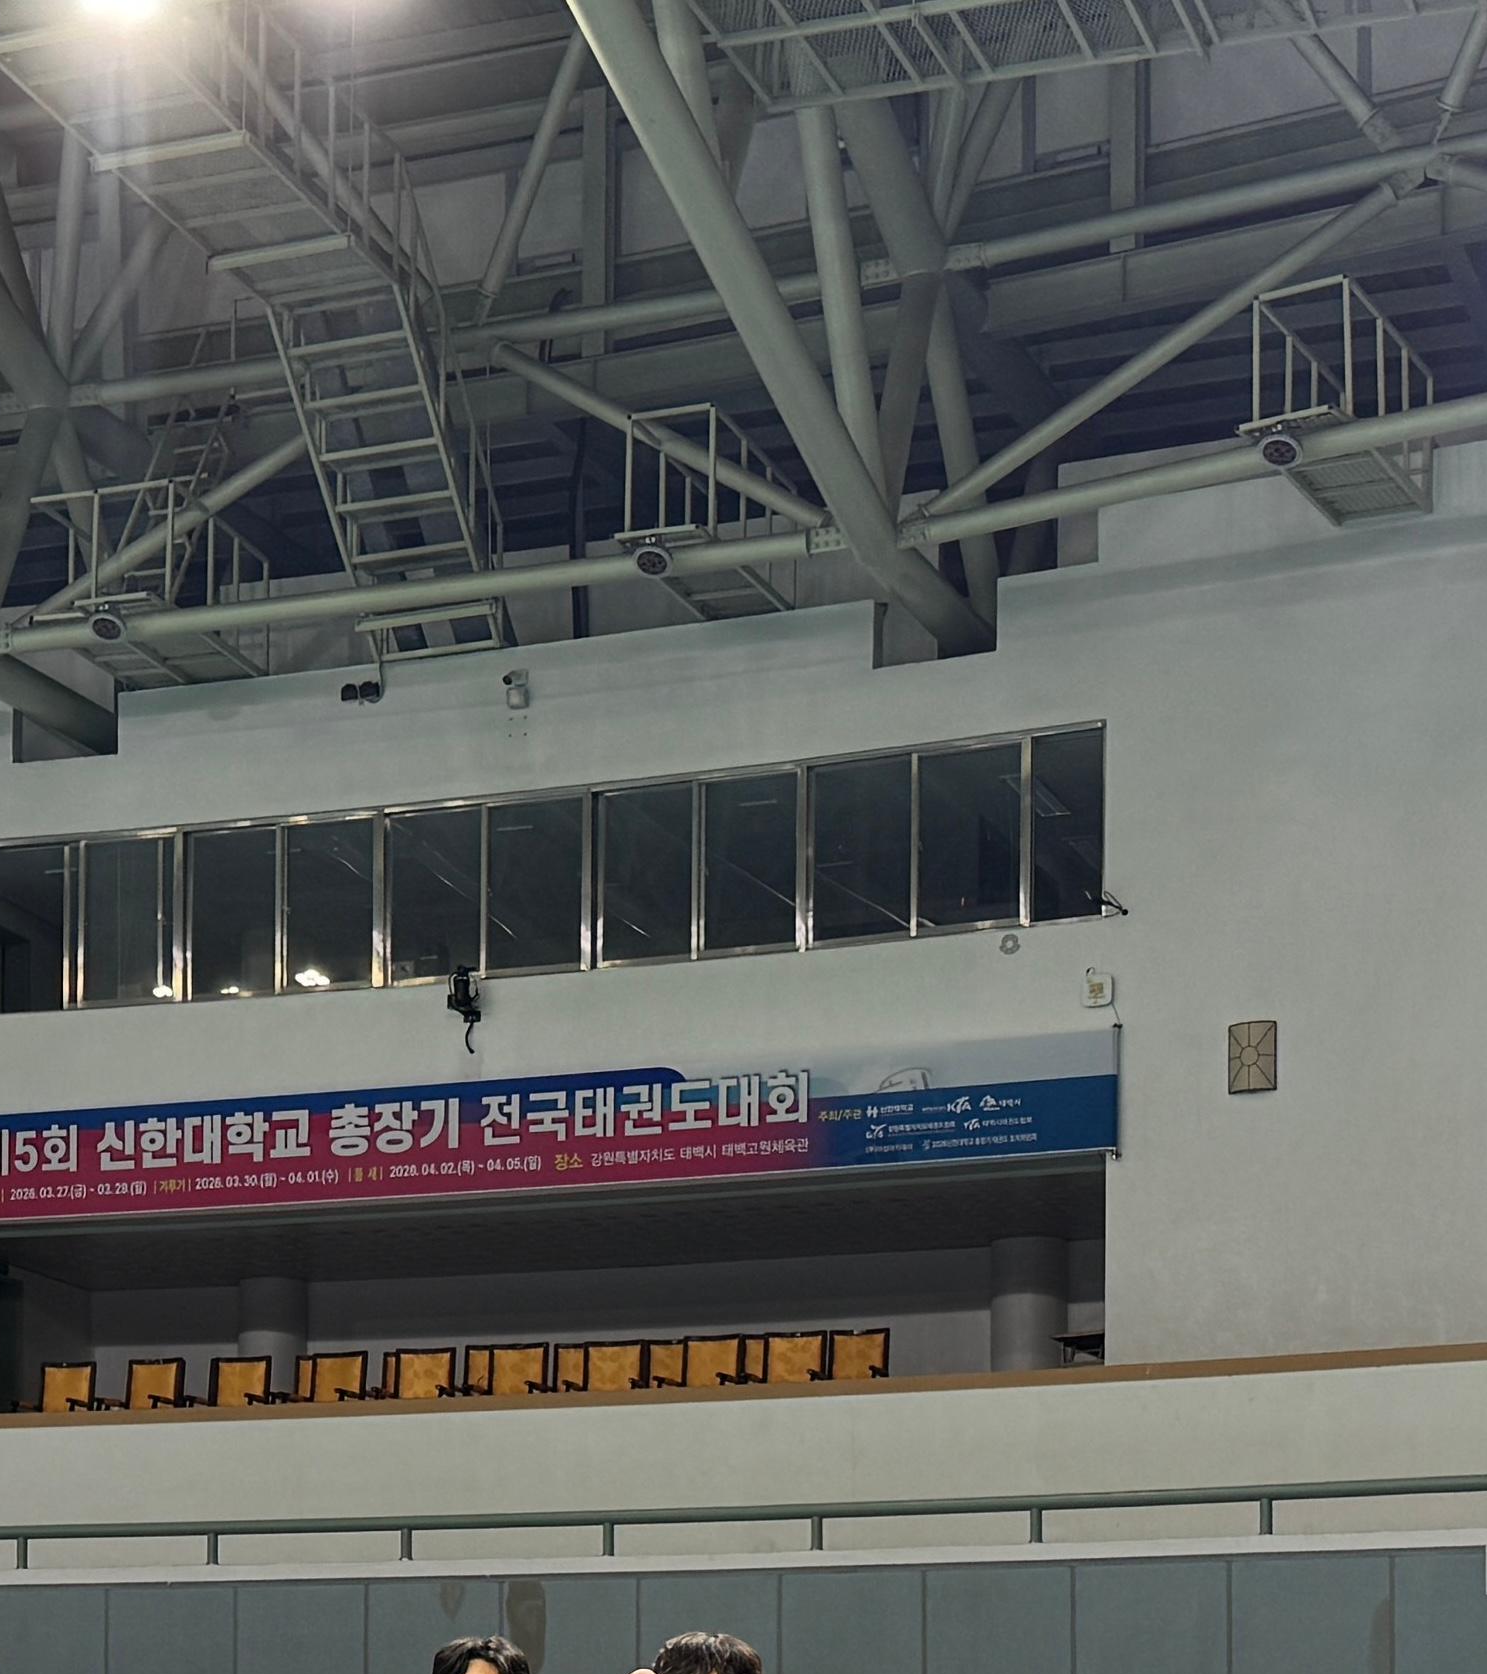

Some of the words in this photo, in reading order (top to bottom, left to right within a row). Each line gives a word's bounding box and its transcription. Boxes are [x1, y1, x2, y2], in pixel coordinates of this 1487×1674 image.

[97, 1109, 311, 1171] 신한대학교
[329, 1098, 459, 1157] 총장기
[480, 1071, 809, 1147] 전국태권도대회
[554, 1153, 583, 1170] 장소
[591, 1148, 675, 1167] 강원특별자치도
[680, 1144, 717, 1159] 태백시
[722, 1137, 809, 1157] 태백고원체육관
